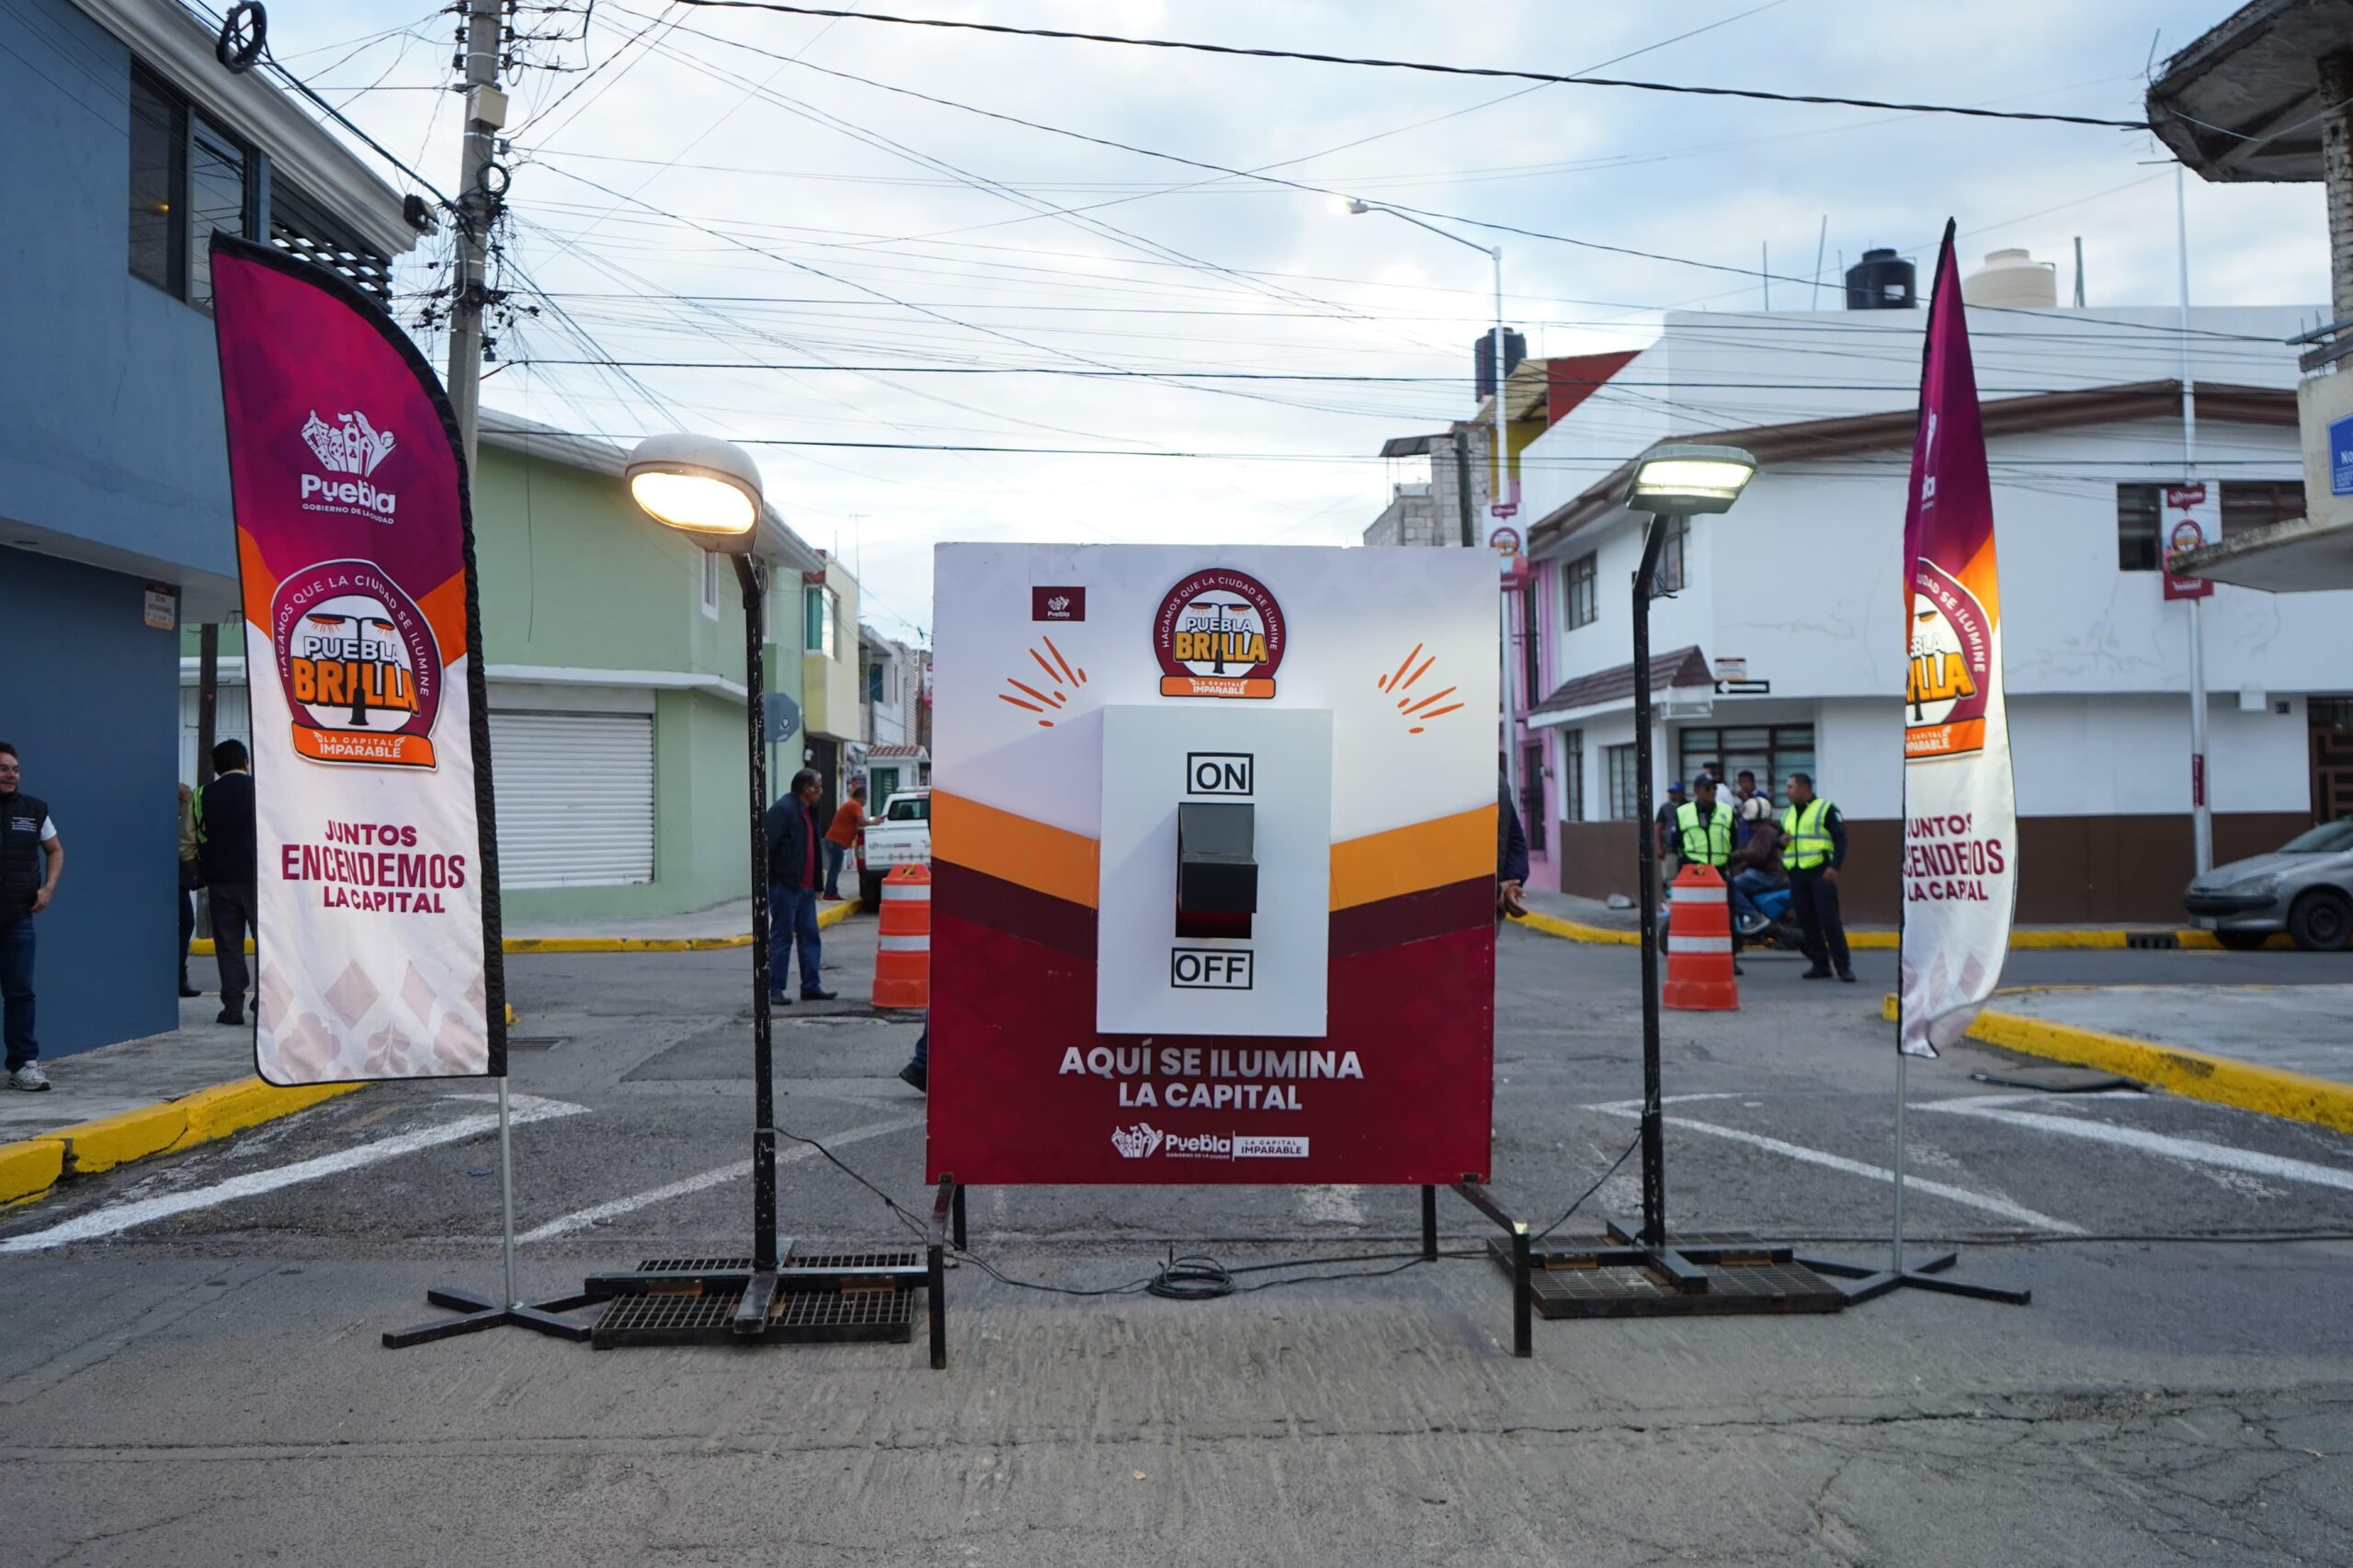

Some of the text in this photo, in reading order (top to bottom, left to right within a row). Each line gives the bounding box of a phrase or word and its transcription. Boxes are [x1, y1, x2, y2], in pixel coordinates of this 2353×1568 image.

[301, 473, 395, 514] Puebla
[302, 503, 349, 513] GOBIERNO
[1162, 577, 1279, 650] HAGAMOS QUE LA CIUDAD SE ILUMINE
[1187, 617, 1254, 632] PUEBLA
[1916, 573, 1985, 672] UDAD SE ILUMINE
[277, 575, 429, 697] HAGAMOS QUE LA CIUDAD SE ILUMINE
[303, 636, 400, 663] PUEBLA
[1175, 631, 1268, 663] BRILLA
[291, 656, 421, 715] BRILLA
[1193, 685, 1245, 695] IMPARABLE
[320, 743, 402, 757] IMPARABLE
[343, 737, 393, 746] CAPITAL
[1196, 763, 1246, 790] ON
[324, 819, 417, 847] JUNTOS
[281, 844, 465, 889] ENCENDEMOS
[324, 885, 446, 913] LA CAPITAL
[1175, 954, 1246, 983] OFF
[1059, 1038, 1364, 1079] AQUÍ SE ILUMINA
[1119, 1082, 1302, 1110] LA CAPITAL
[1165, 1133, 1231, 1153] Puebla
[1241, 1146, 1302, 1154] IMPARABLE
